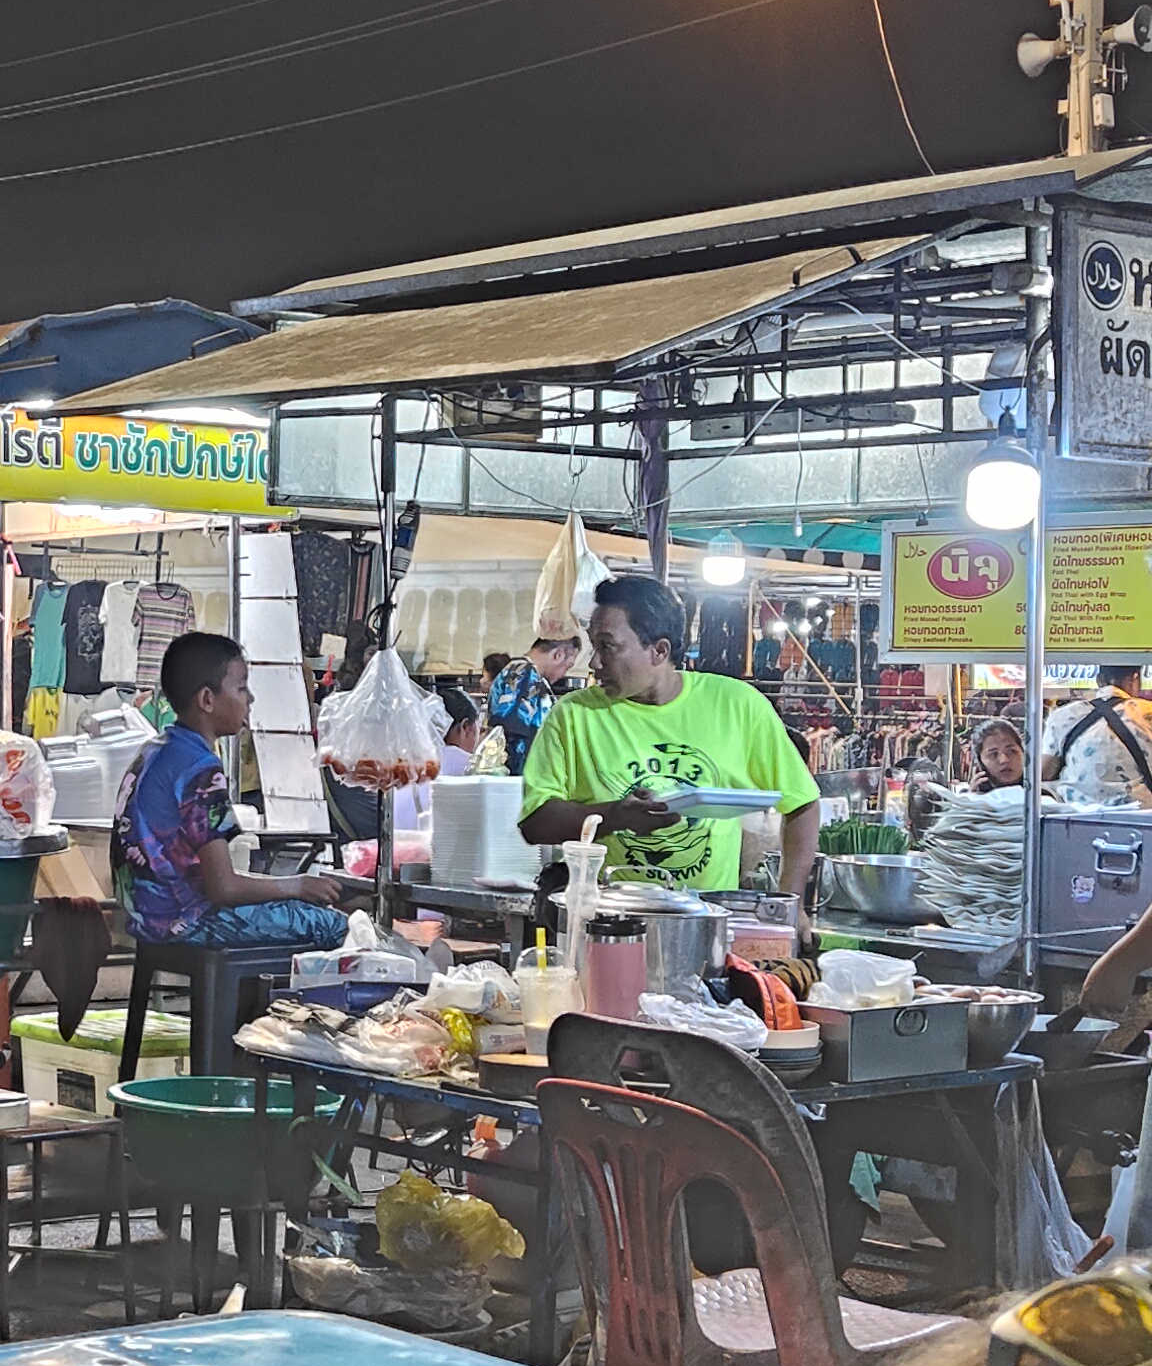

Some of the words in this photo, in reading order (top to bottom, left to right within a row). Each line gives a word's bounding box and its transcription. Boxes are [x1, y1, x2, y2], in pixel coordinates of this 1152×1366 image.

[0, 412, 63, 468] โรตี
[626, 757, 703, 782] 2013
[645, 846, 712, 881] SURVIVED
